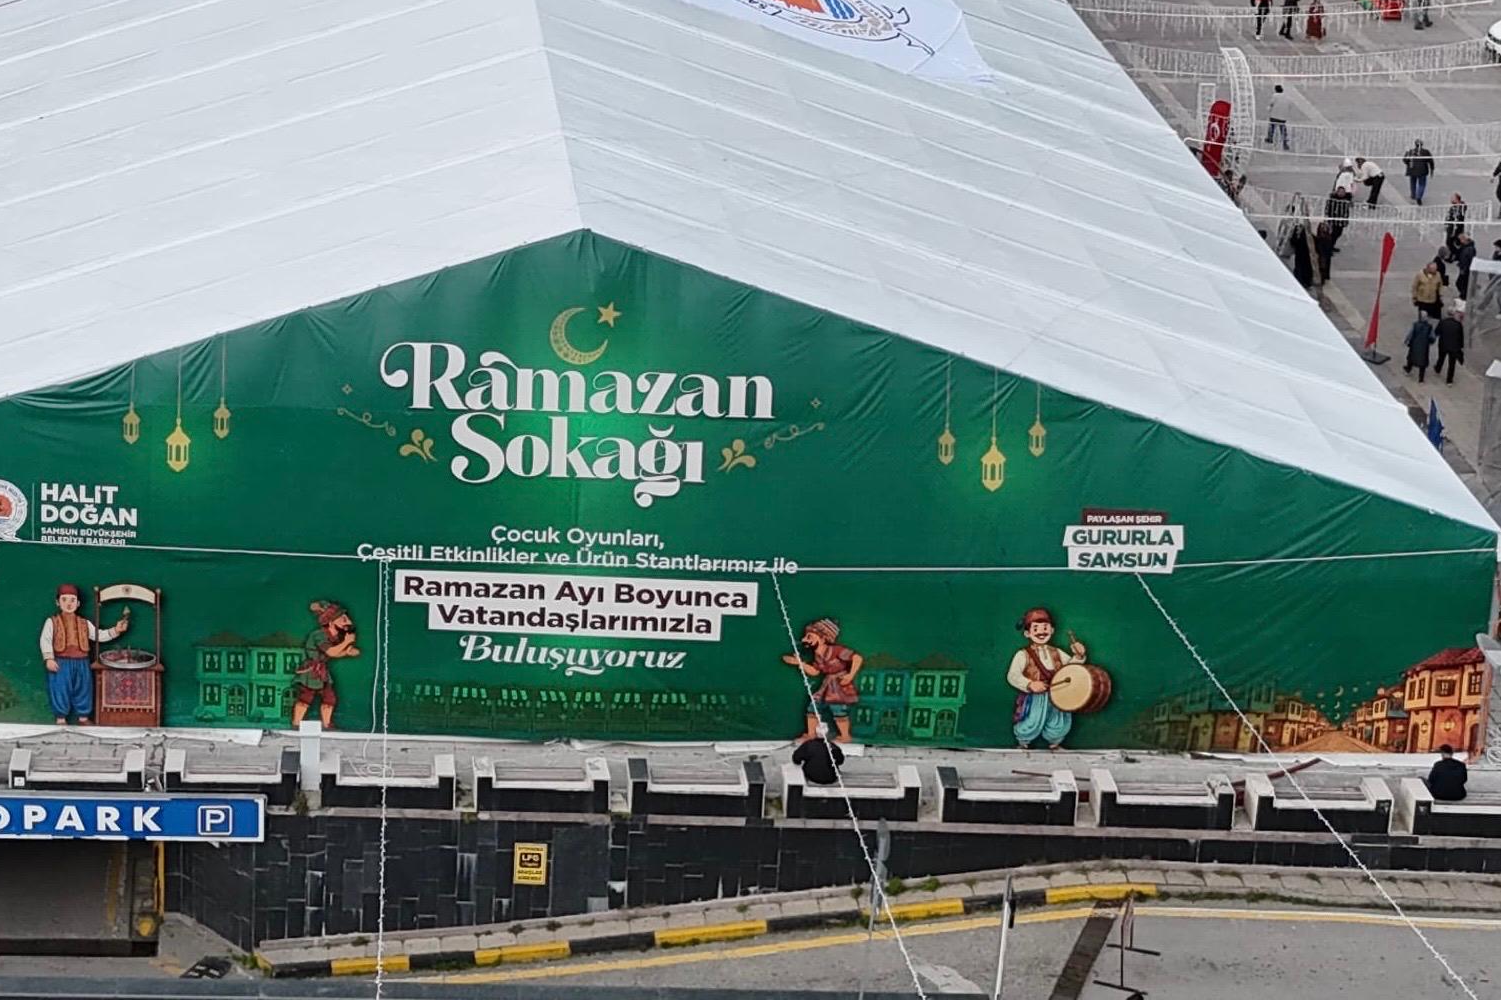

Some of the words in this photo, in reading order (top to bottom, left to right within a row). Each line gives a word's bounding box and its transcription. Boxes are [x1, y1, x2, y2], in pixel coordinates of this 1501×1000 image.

[450, 411, 706, 509] Sokağı
[40, 482, 119, 504] HALİT
[40, 502, 138, 527] DOĞAN
[1086, 514, 1134, 524] PAYLAŞAN
[41, 526, 79, 536] SAMSUN
[80, 527, 137, 539] BÜYÜKŞEHİR
[490, 524, 560, 547] Çocuk
[566, 527, 666, 550] Oyunları,
[1072, 529, 1175, 546] GURURLA
[430, 545, 539, 566] Etkinlikler
[545, 551, 571, 567] ve
[576, 547, 629, 568] Ürün
[635, 552, 767, 574] Stantlarımız
[773, 557, 799, 575] ile
[1077, 552, 1168, 568] SAMSUN
[403, 575, 546, 601] Ramazan
[554, 580, 606, 606] Ayı
[615, 583, 750, 610] Boyunca
[437, 604, 713, 635] Vatandaşlarımızla
[459, 634, 687, 677] Buluşuyoruz
